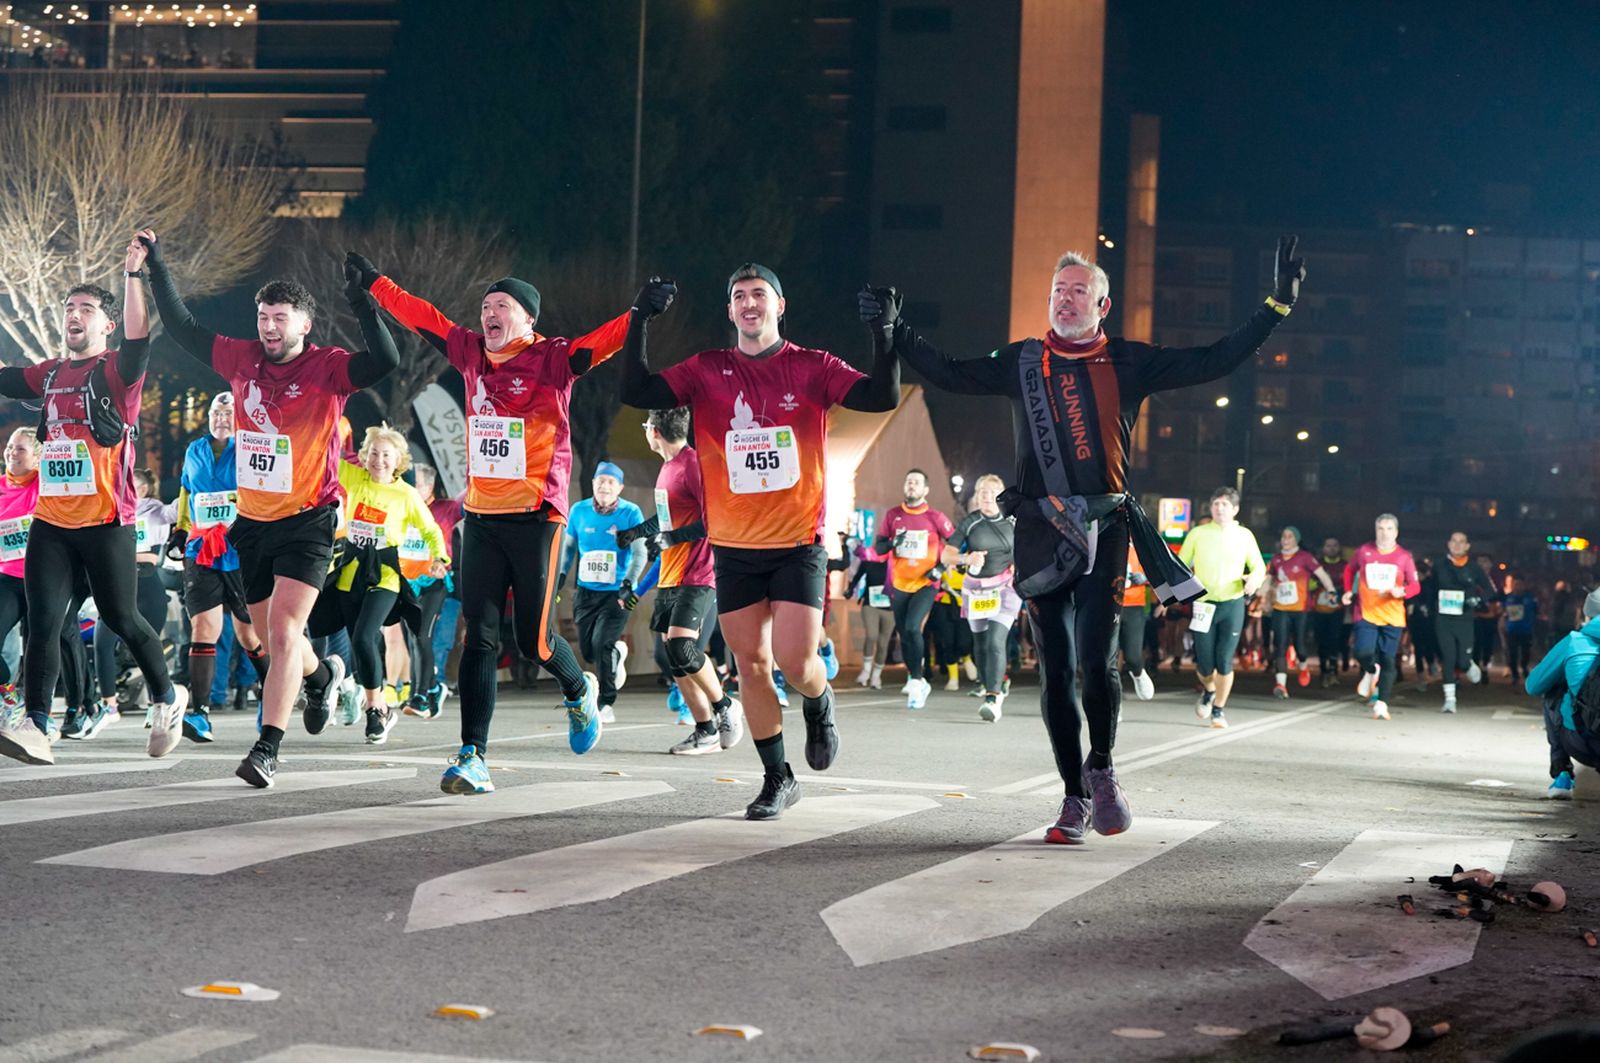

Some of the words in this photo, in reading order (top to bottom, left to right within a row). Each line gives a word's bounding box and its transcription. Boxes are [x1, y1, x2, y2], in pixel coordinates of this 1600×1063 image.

[251, 407, 267, 425] 43
[1026, 367, 1057, 470] GRANADA
[1059, 373, 1091, 461] RUNNING
[480, 438, 509, 457] 456
[48, 460, 83, 477] 8307
[249, 453, 276, 472] 457
[745, 451, 780, 471] 455
[206, 505, 230, 518] 7877
[4, 531, 28, 546] 4353
[587, 561, 609, 572] 1063
[974, 599, 996, 610] 6969
